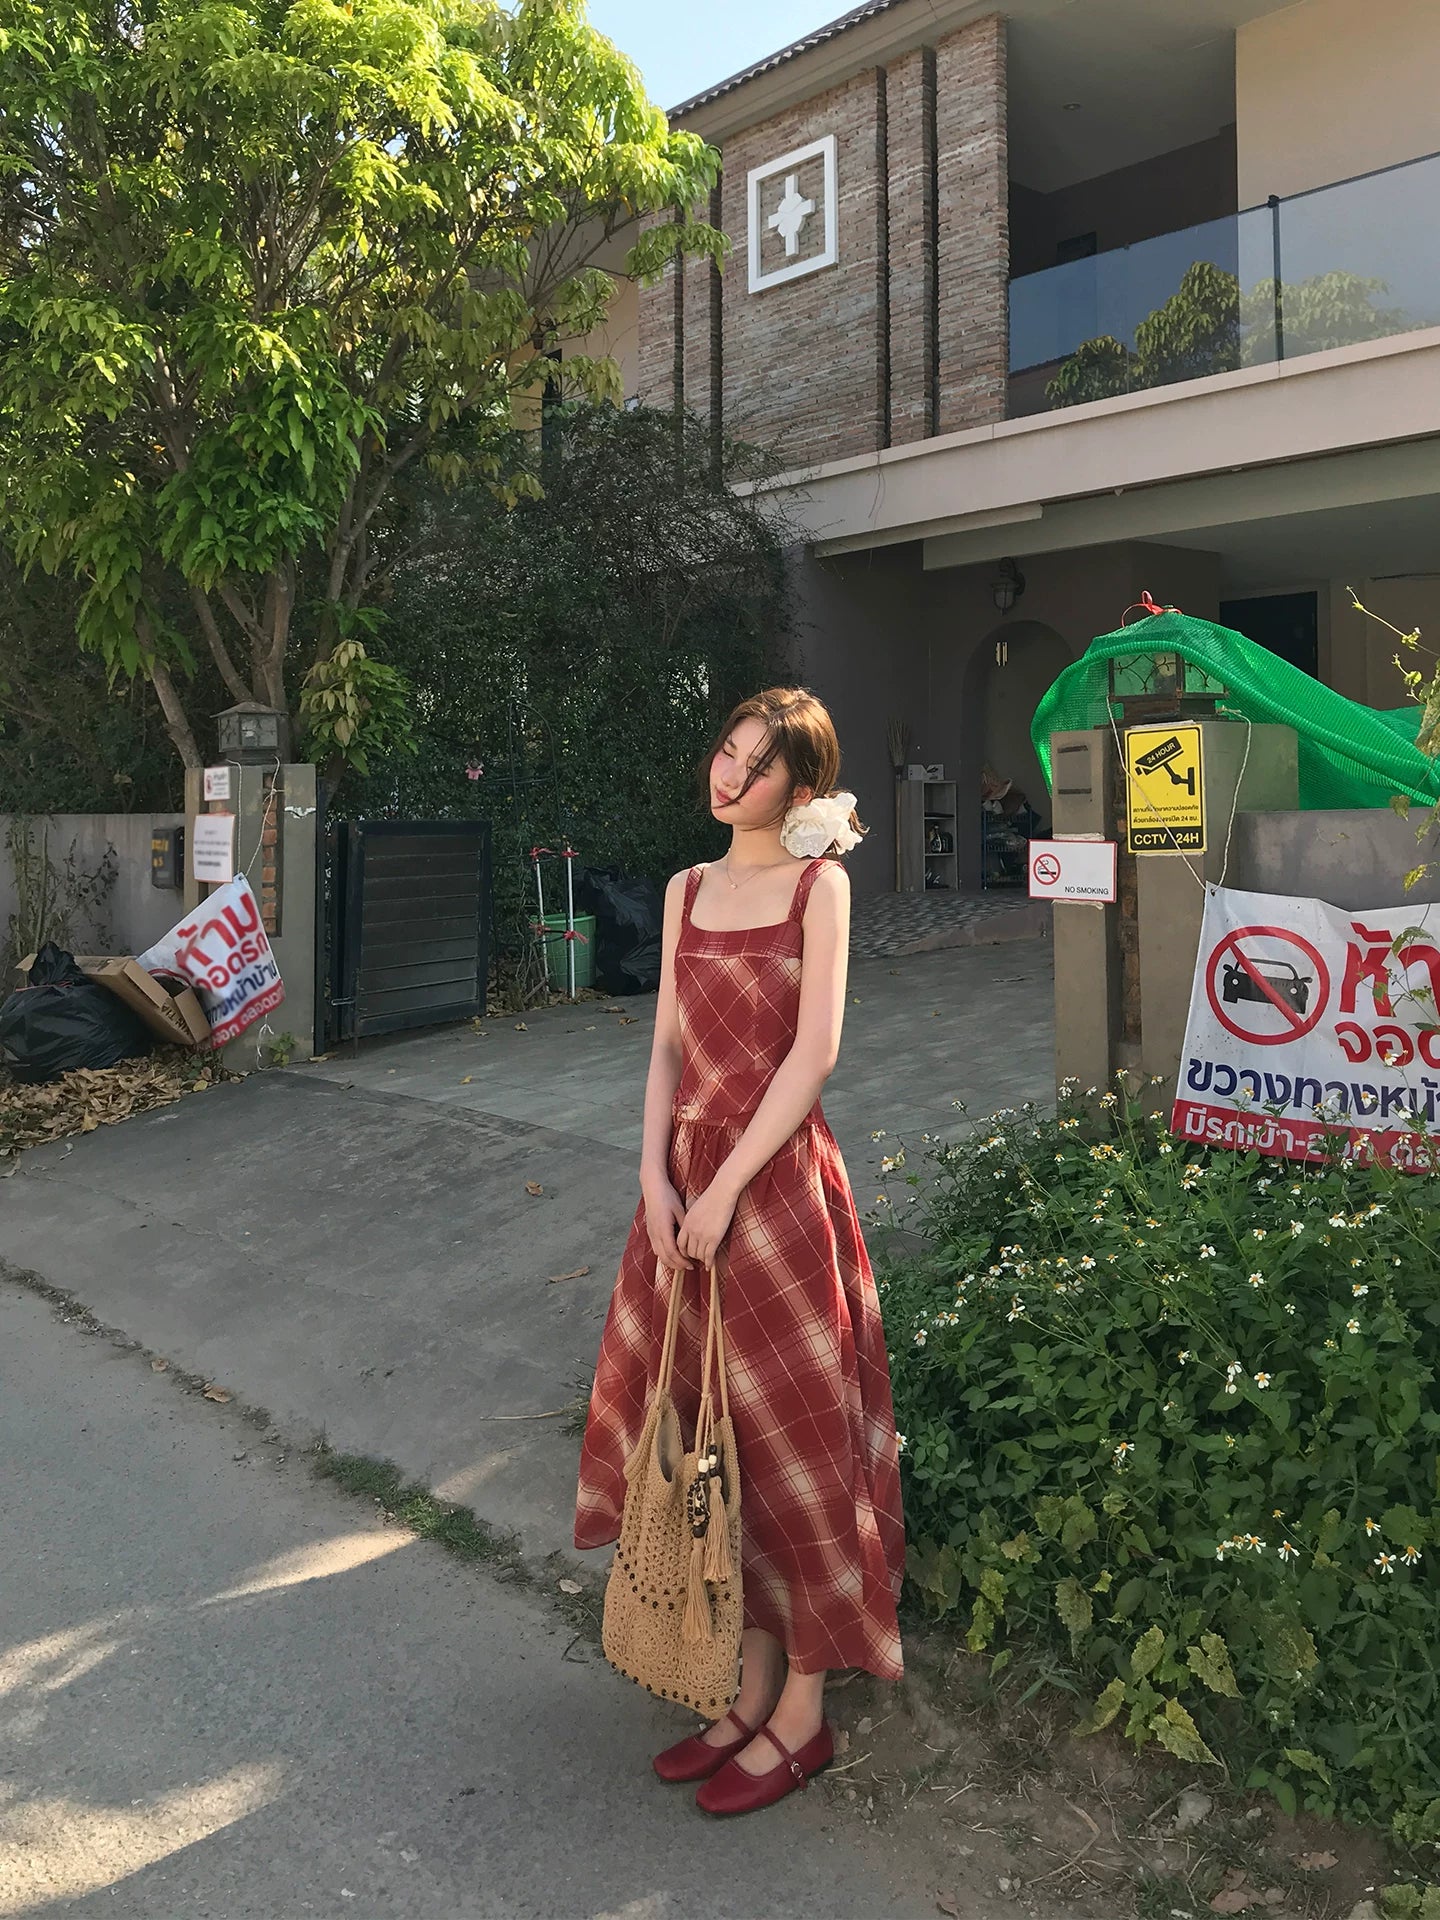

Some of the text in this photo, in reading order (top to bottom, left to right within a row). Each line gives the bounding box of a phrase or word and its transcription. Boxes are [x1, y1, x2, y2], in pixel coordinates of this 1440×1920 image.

[1147, 742, 1176, 763] 24 HOUR
[1134, 832, 1199, 845] CCTV 24H
[1076, 887, 1108, 895] SMOKING
[1187, 1058, 1440, 1122] ขวางทางหน้
